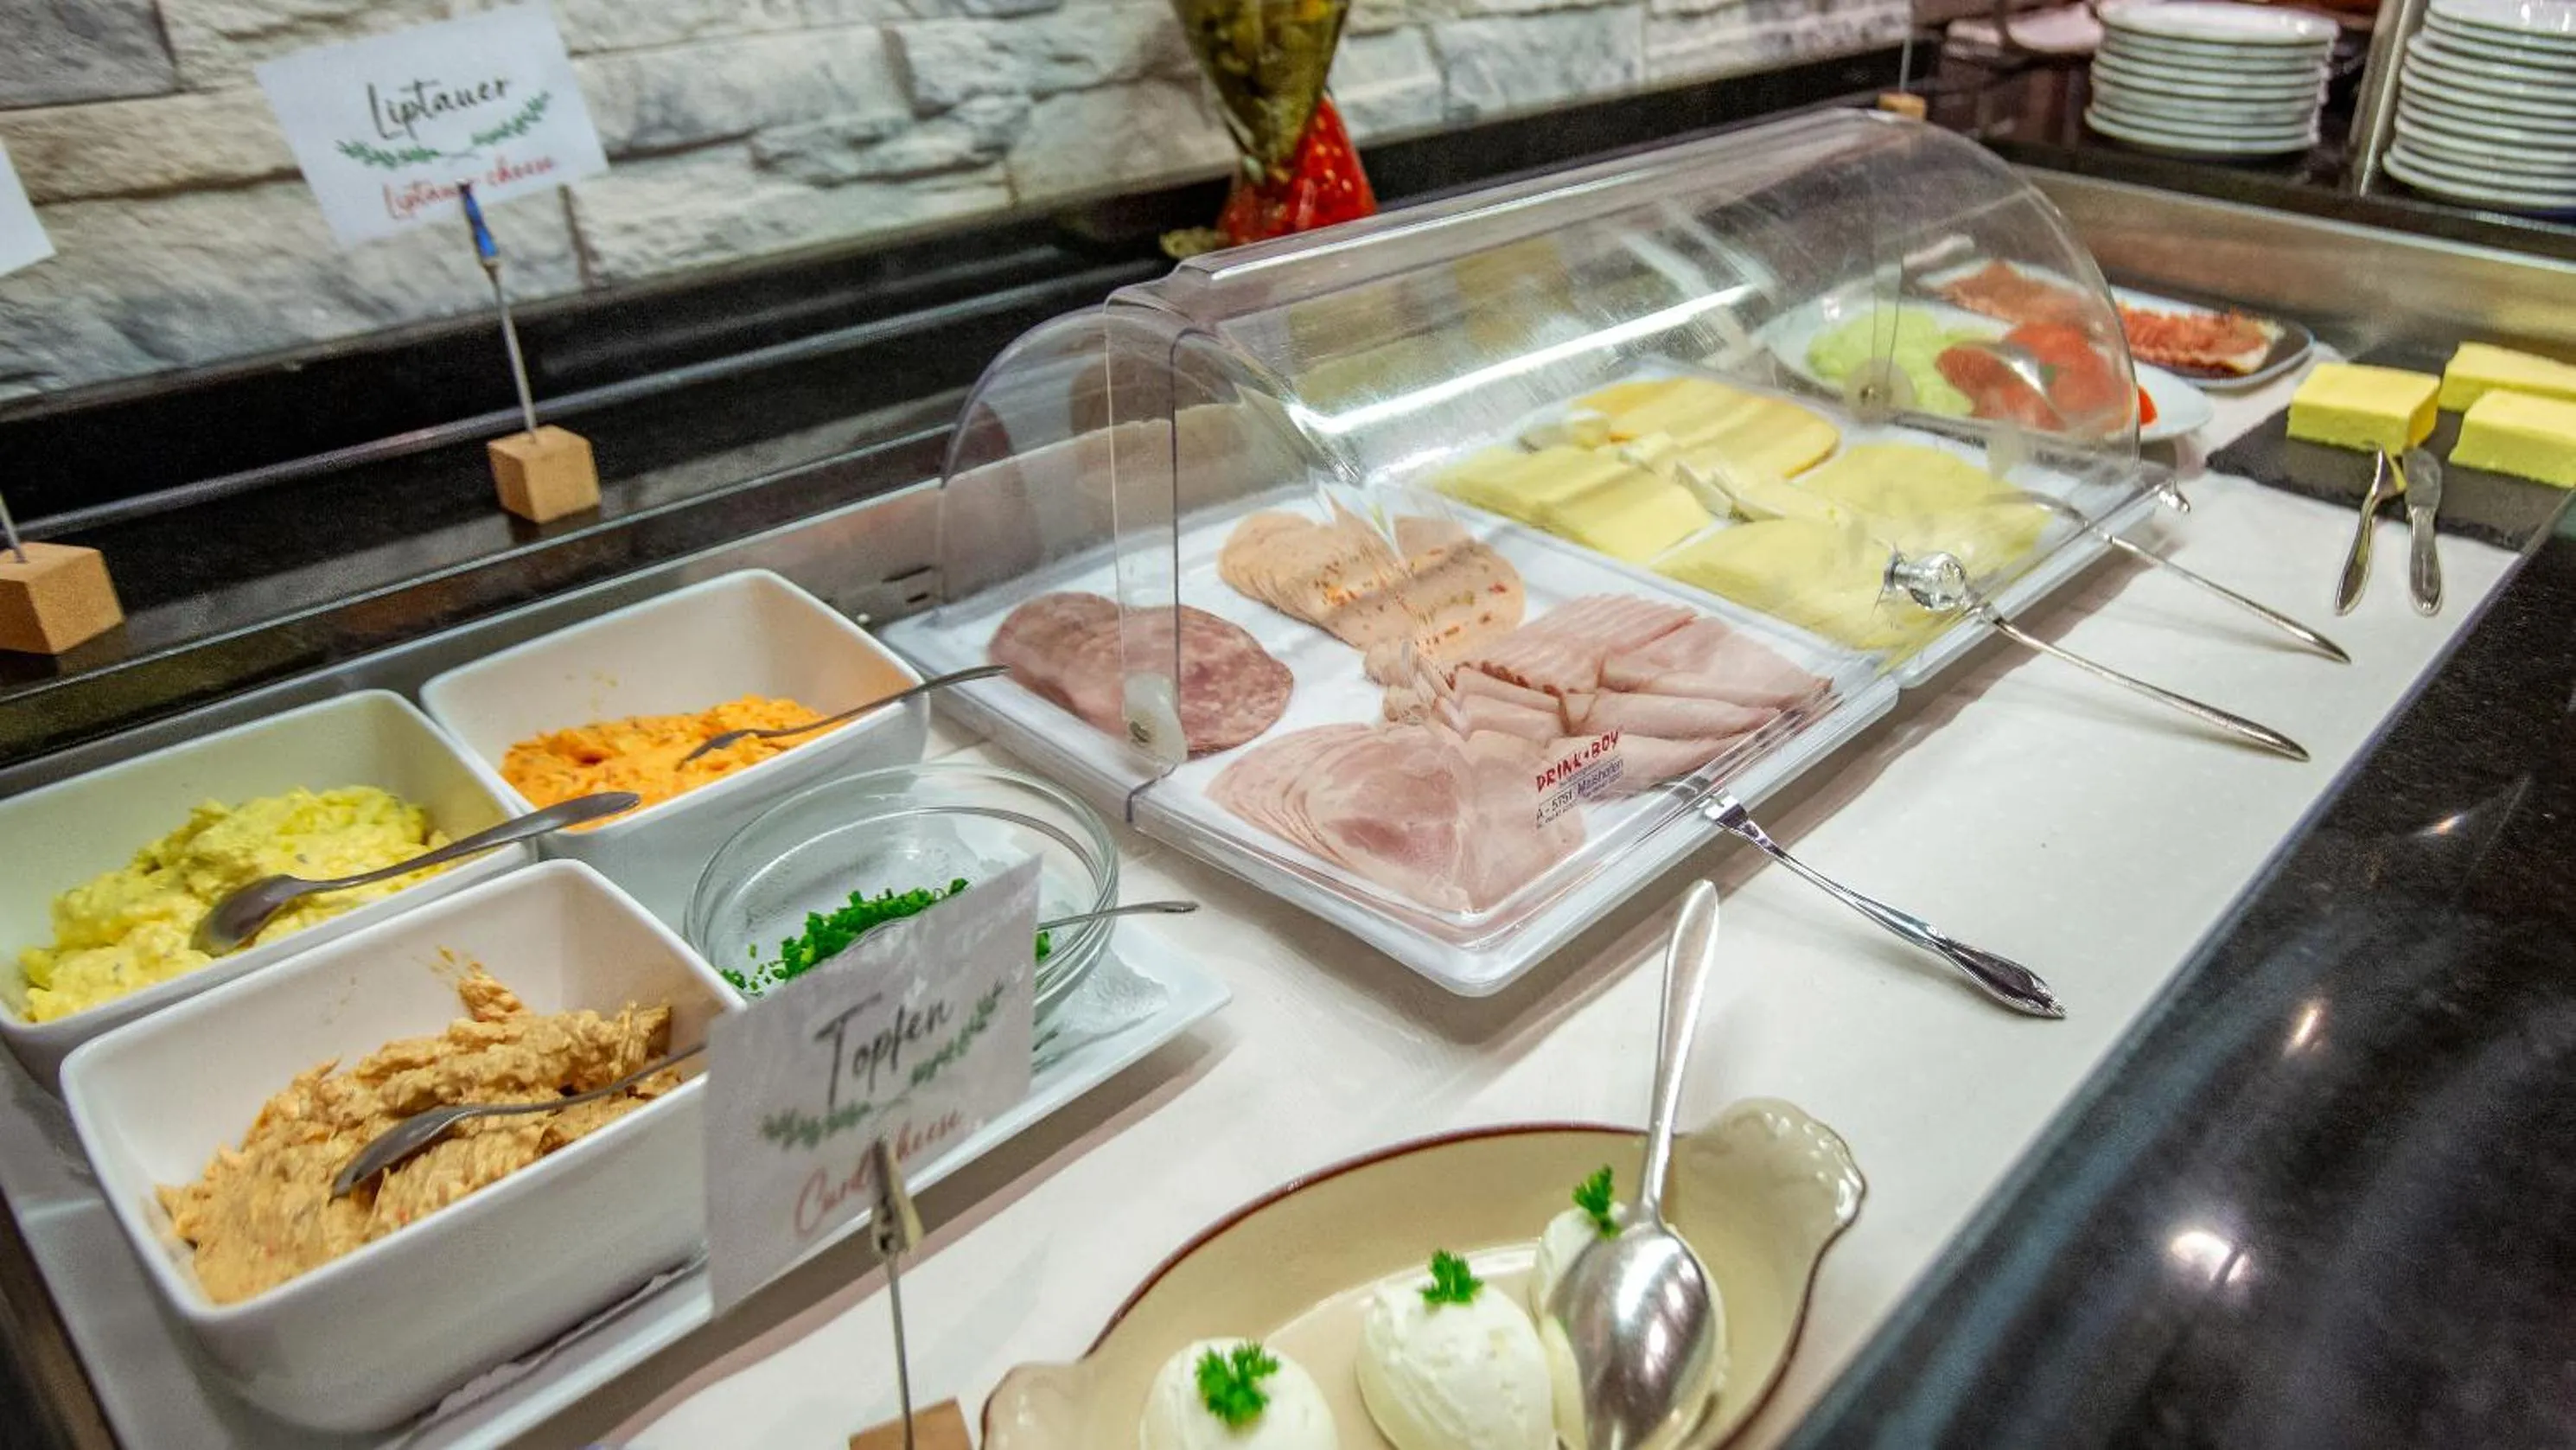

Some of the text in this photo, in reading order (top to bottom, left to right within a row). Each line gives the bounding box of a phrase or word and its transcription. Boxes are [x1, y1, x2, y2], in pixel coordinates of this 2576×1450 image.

[367, 77, 513, 141] Liptauer
[814, 992, 952, 1108] Topfen
[894, 1111, 961, 1161] heese
